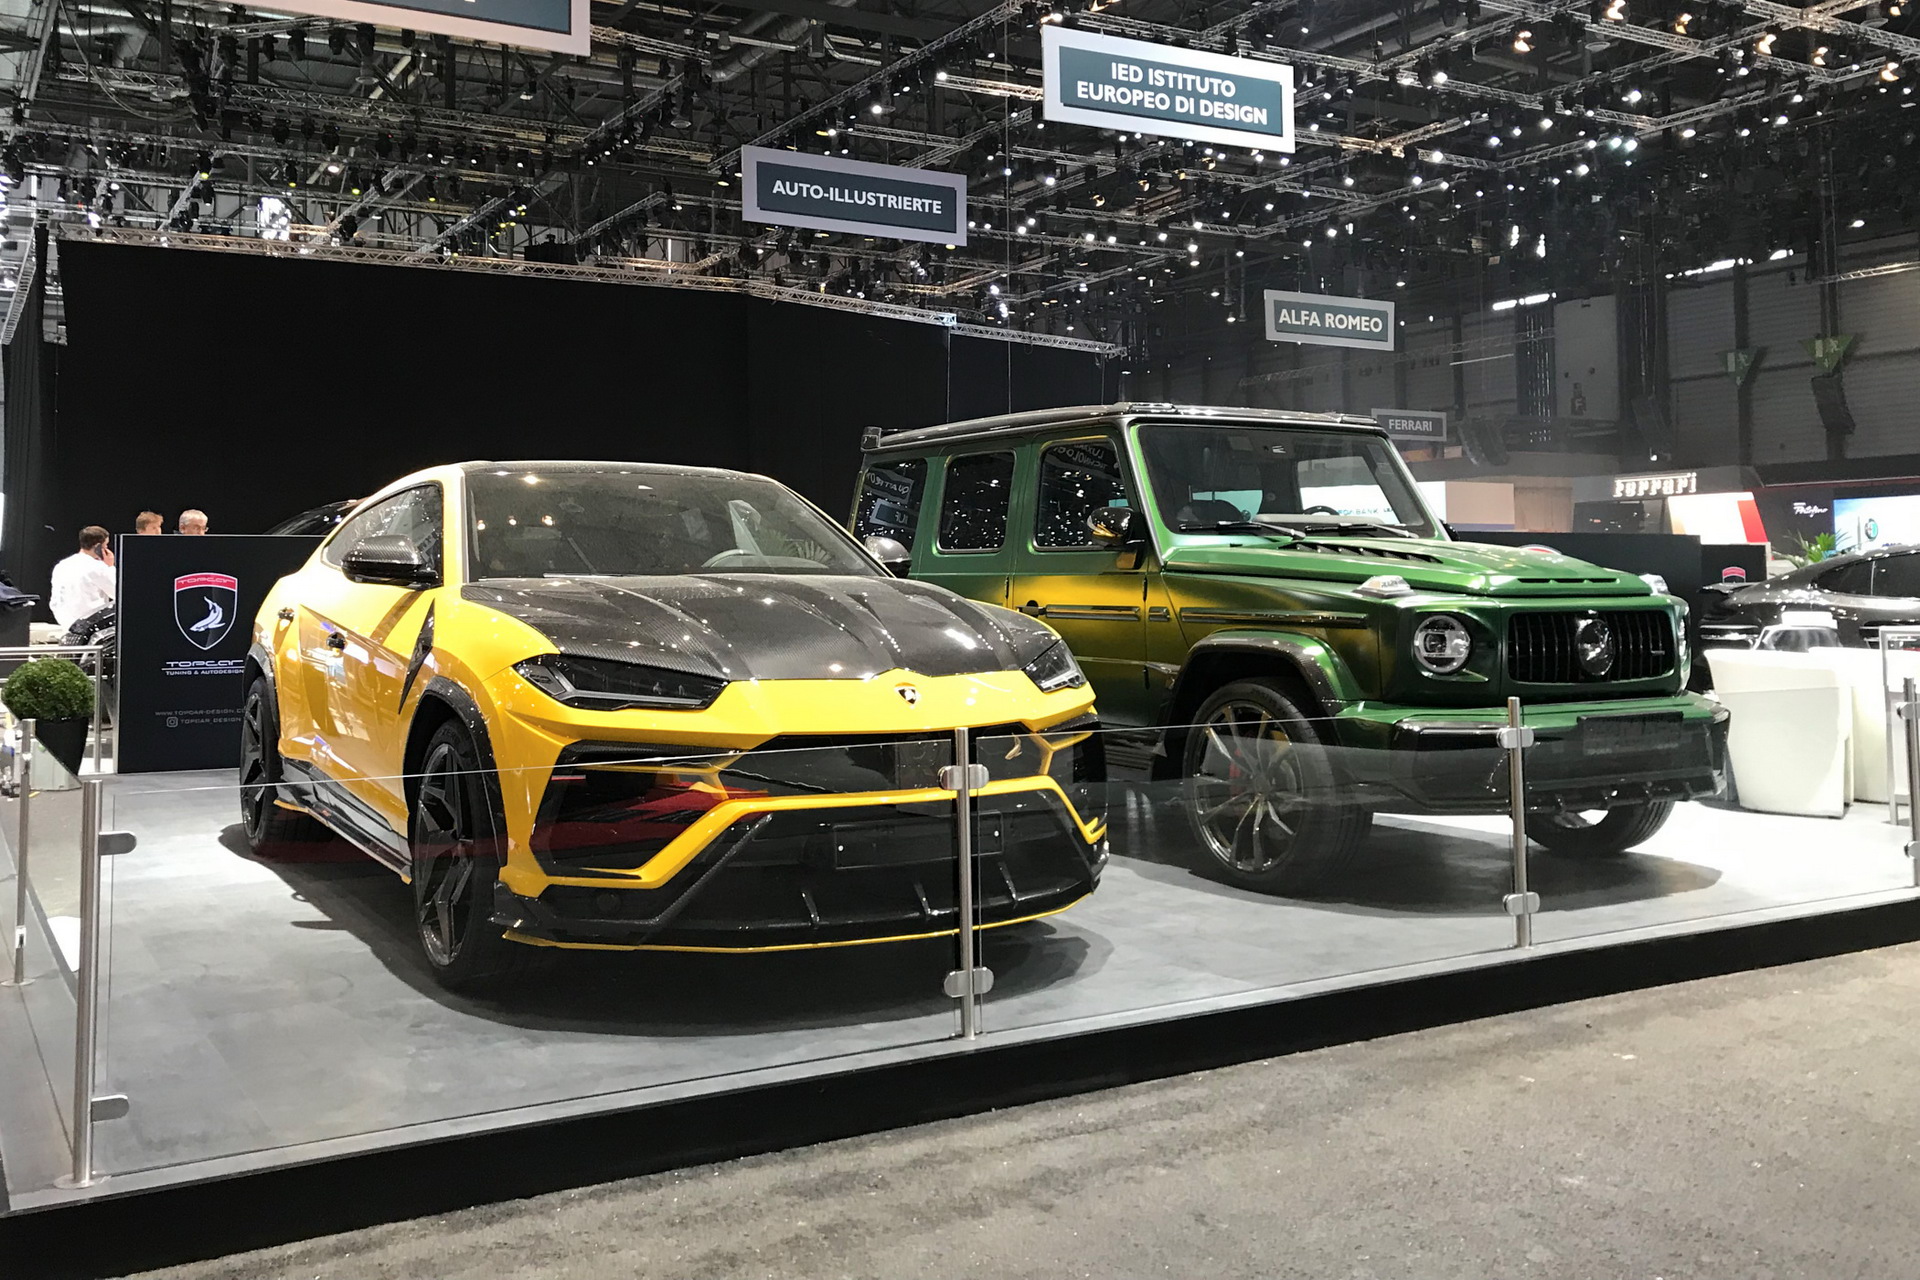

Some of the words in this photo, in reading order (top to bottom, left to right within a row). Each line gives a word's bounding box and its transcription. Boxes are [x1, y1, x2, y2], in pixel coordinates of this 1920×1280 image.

[1111, 62, 1143, 83] IED
[1148, 68, 1236, 98] ISTITUTO
[1077, 81, 1170, 111] EUROPEO
[1175, 98, 1195, 115] DI
[1200, 100, 1267, 125] DESIGN
[772, 179, 942, 215] AUTO-ILLUSTRIERTE
[1279, 308, 1321, 327] ALFA
[1325, 312, 1383, 333] ROMEO
[1388, 418, 1433, 432] FERRARI
